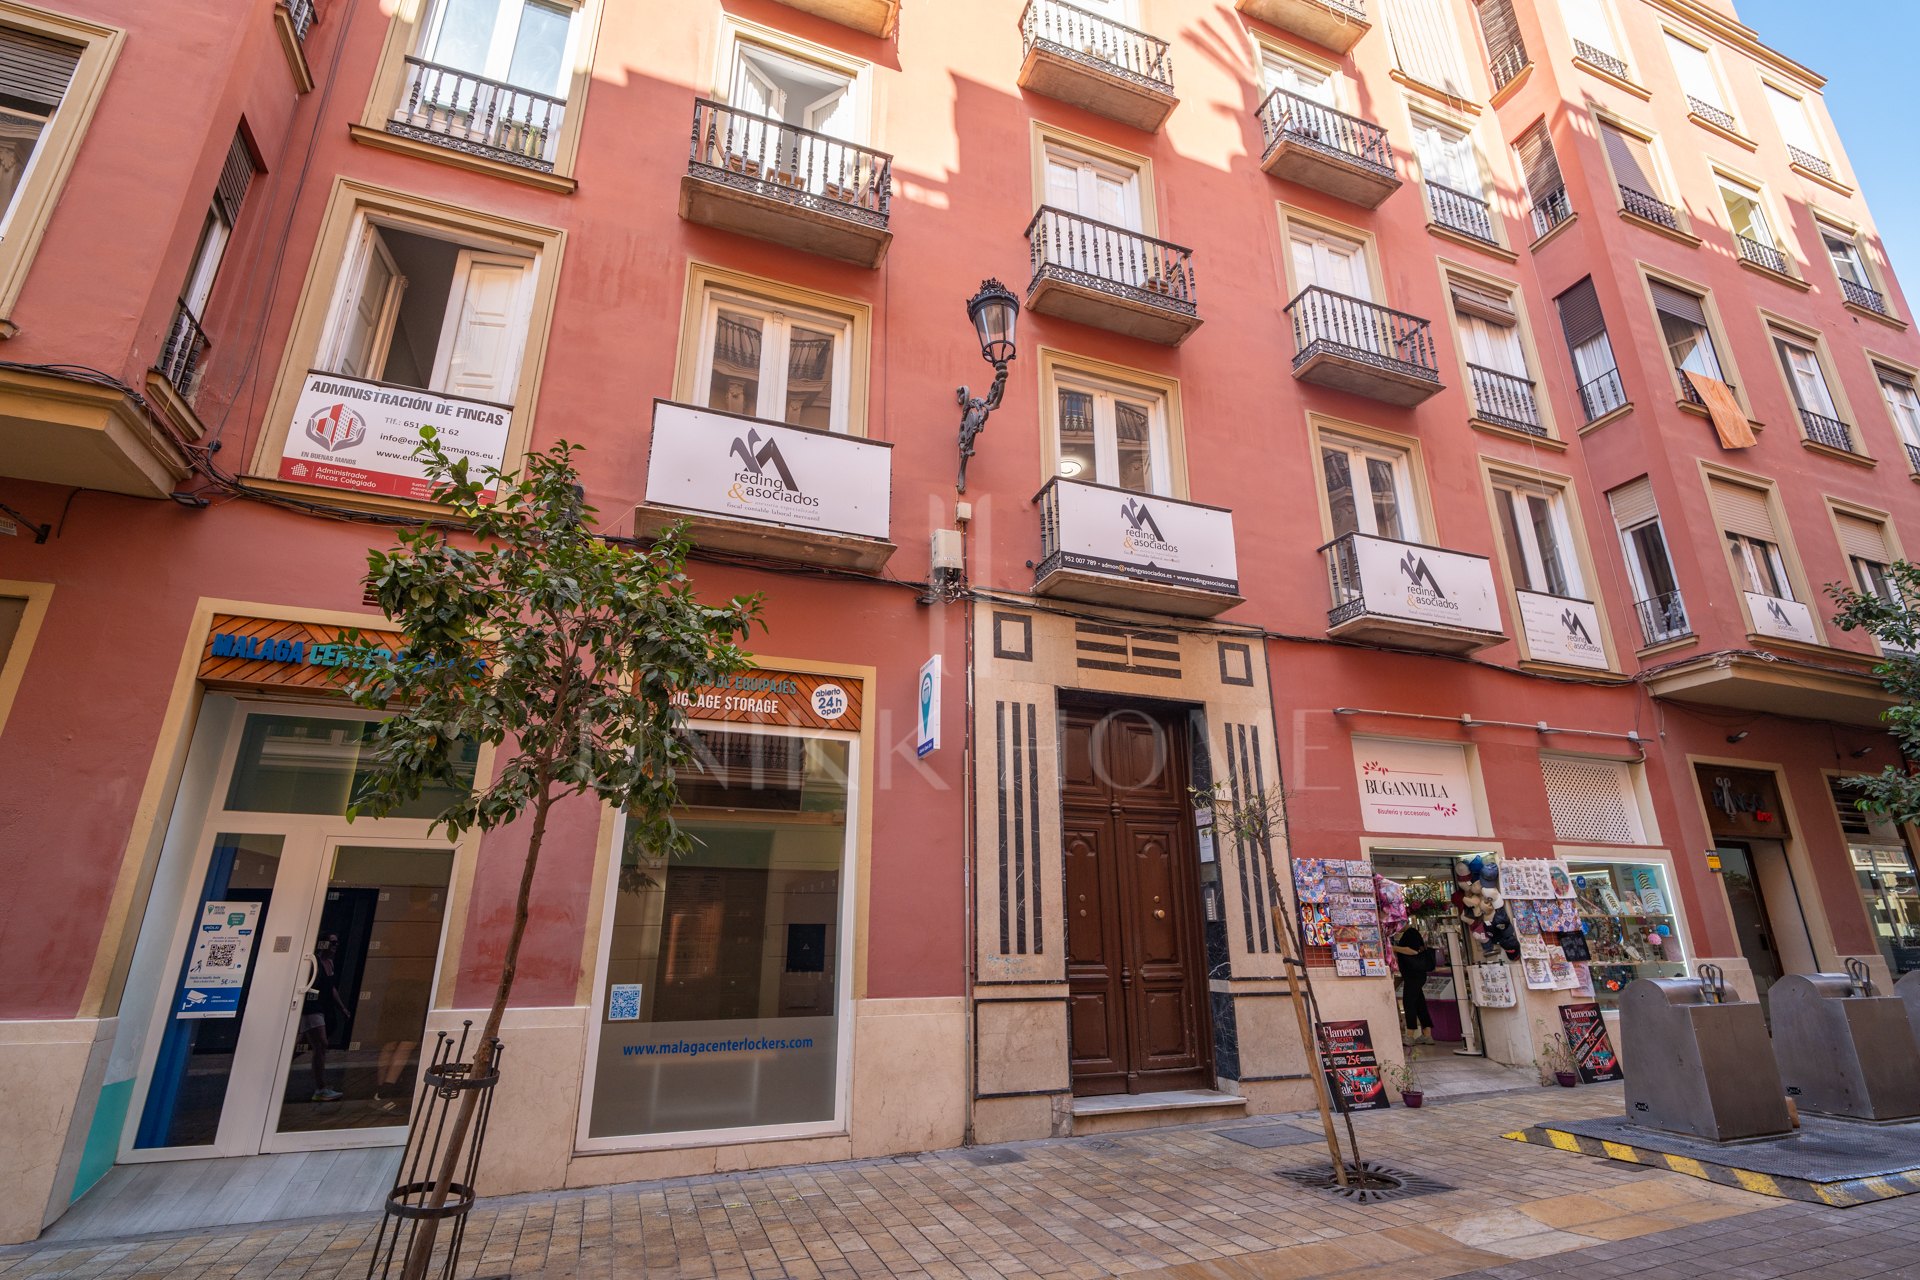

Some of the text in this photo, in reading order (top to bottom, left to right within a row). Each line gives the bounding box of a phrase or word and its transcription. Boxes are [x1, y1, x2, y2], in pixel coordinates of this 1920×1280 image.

[311, 380, 504, 426] ADMINISTRACIÓN DE FINCAS
[403, 420, 419, 429] 651
[448, 428, 460, 437] 62
[380, 432, 494, 460] info@enasmanos.eu
[310, 451, 334, 462] BUENAS
[335, 456, 357, 465] MANOS
[315, 473, 377, 488] Fincas Colegiado
[316, 466, 368, 480] Administrador
[734, 471, 783, 492] reding
[745, 486, 819, 507] asociados
[744, 505, 770, 514] contable
[771, 510, 792, 518] laboral
[1125, 529, 1156, 543] reding
[1133, 539, 1179, 553] asociados
[1064, 555, 1075, 563] 952
[1176, 575, 1236, 590] www.redingyasociados.es
[1407, 584, 1436, 600] reding
[1415, 596, 1459, 610] asociados
[210, 632, 305, 665] MALAGA
[734, 675, 797, 695] EQUIPAJES
[815, 688, 841, 698] abierto
[724, 695, 779, 714] STORAGE
[821, 707, 842, 716] open
[1365, 779, 1449, 799] BUGANVILLA
[1565, 1008, 1598, 1019] Flamenco
[1322, 1026, 1364, 1038] Flamenco
[622, 1036, 814, 1057] www.malagacenterlockers.com
[1346, 1054, 1361, 1065] 25€
